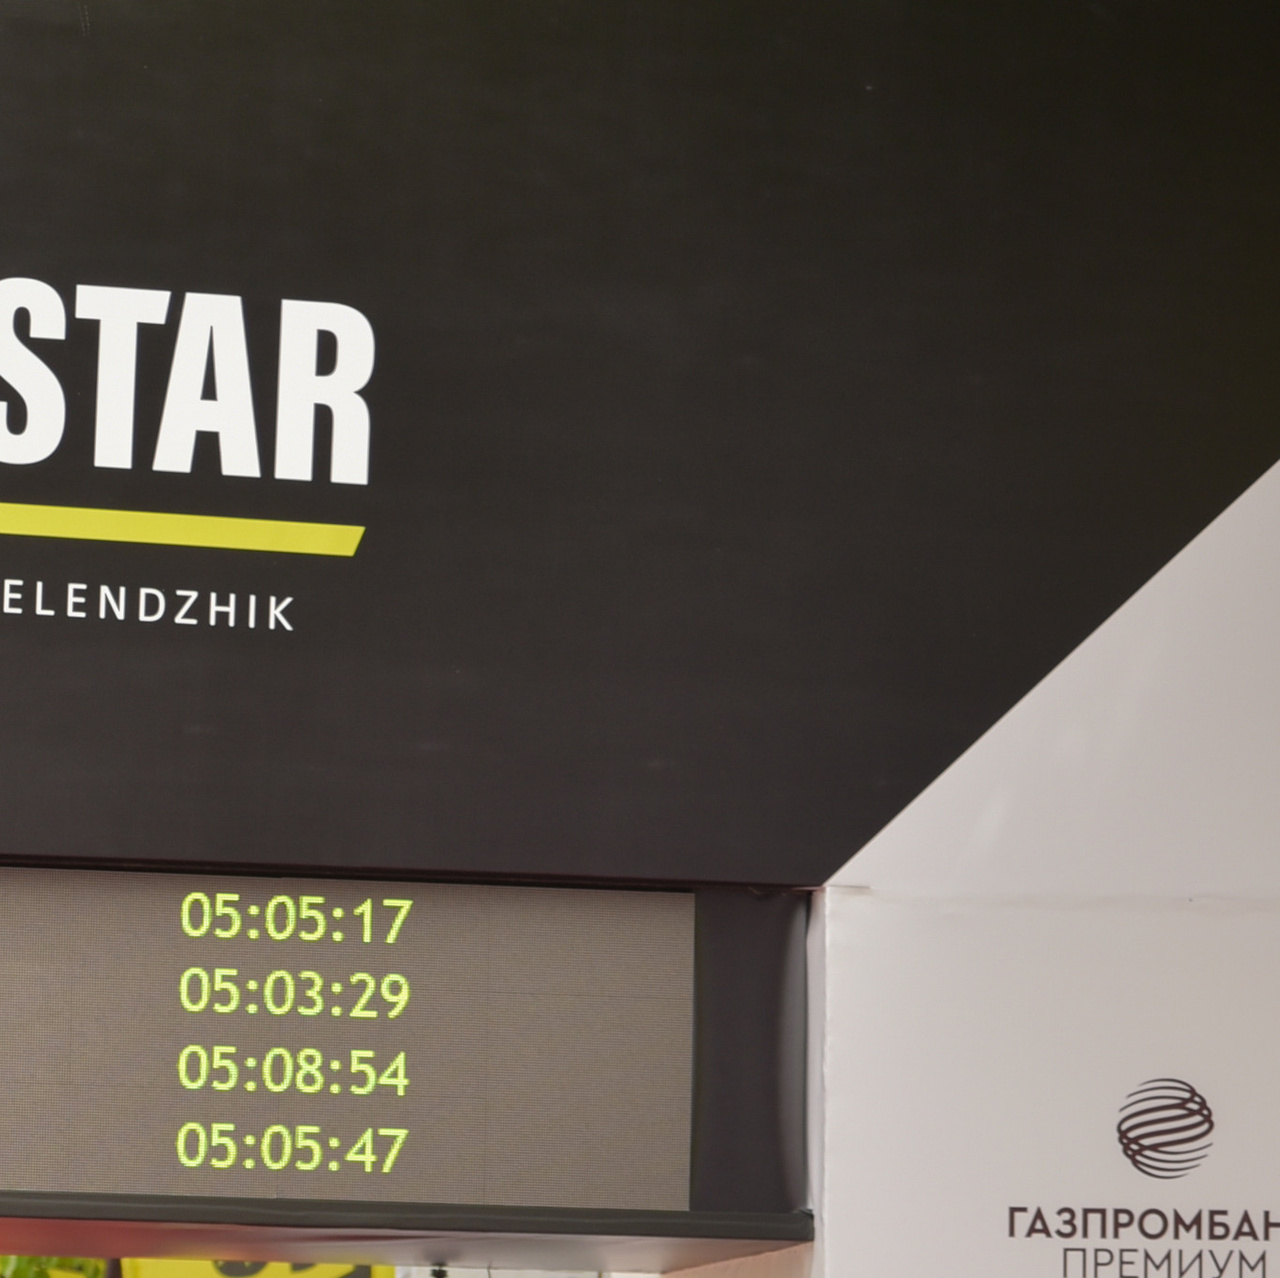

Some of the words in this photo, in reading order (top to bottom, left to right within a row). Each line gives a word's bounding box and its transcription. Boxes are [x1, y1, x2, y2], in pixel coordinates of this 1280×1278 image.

[180, 891, 414, 944] 05:05:17
[179, 966, 411, 1019] 05:03:29
[177, 1044, 411, 1097] 05:08:54
[175, 1121, 410, 1174] 05:05:47
